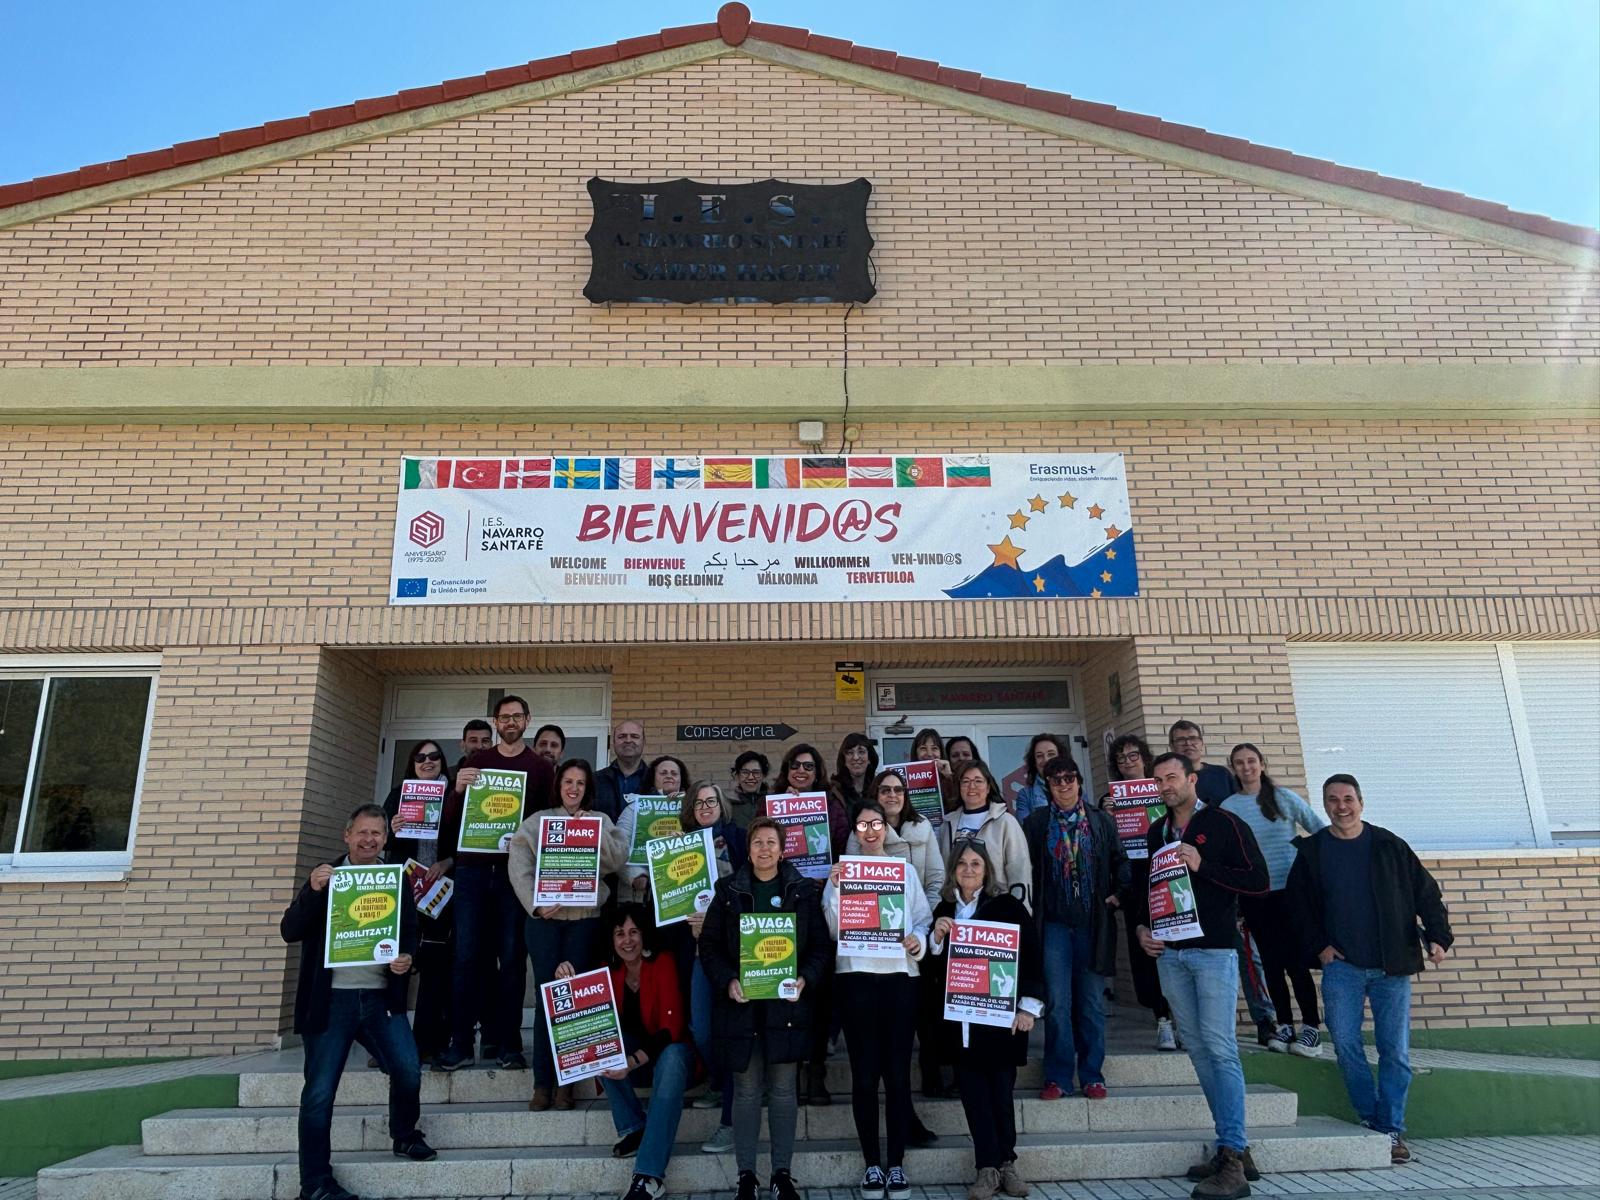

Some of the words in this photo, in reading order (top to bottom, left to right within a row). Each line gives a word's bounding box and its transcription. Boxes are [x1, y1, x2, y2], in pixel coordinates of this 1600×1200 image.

[1030, 463, 1096, 475] Erasmus+
[482, 518, 505, 527] I.E.S.
[576, 499, 903, 545] BIENVENID@S
[482, 527, 544, 540] NAVARRO
[481, 538, 543, 551] SANTAFÉ
[550, 557, 607, 570] WELCOME
[624, 558, 686, 570] BIENVENUE
[794, 556, 870, 569] WILLKOMMEN
[891, 553, 962, 565] VEN-VIND@S
[475, 579, 488, 587] por
[564, 573, 627, 586] BENVENUTI
[648, 574, 672, 589] HOŞ
[757, 572, 818, 585] VÄLKOMNA
[846, 571, 915, 585] TERVETULOA
[430, 586, 437, 594] la
[438, 586, 458, 594] Unión
[459, 587, 487, 595] Europea
[487, 775, 522, 788] VAGA
[909, 771, 933, 781] MARÇ
[406, 783, 417, 793] 31
[417, 785, 441, 795] MARÇ
[1112, 784, 1127, 798] 31
[653, 800, 682, 811] VAGA
[772, 800, 787, 814] 31
[789, 800, 822, 811] MARÇ
[551, 822, 563, 830] 12
[791, 815, 824, 824] EDUCATIVA
[549, 834, 563, 843] 24
[567, 829, 594, 838] MARÇ
[666, 833, 702, 850] VAGA
[1158, 852, 1180, 865] MARÇ
[844, 862, 861, 878] 31
[864, 866, 900, 879] MARÇ
[334, 880, 351, 890] MARÇ
[354, 872, 396, 885] VAGA
[864, 884, 902, 892] EDUCATIVA
[757, 917, 793, 929] VAGA
[335, 925, 393, 940] MOBILITZA'T!
[956, 926, 973, 942] 31
[975, 930, 1013, 946] MARÇ
[974, 948, 1014, 959] EDUCATIVA
[554, 985, 569, 996] 12
[556, 999, 572, 1011] 24
[574, 983, 604, 998] MARÇ
[555, 1004, 610, 1023] CONCENTRACIONS
